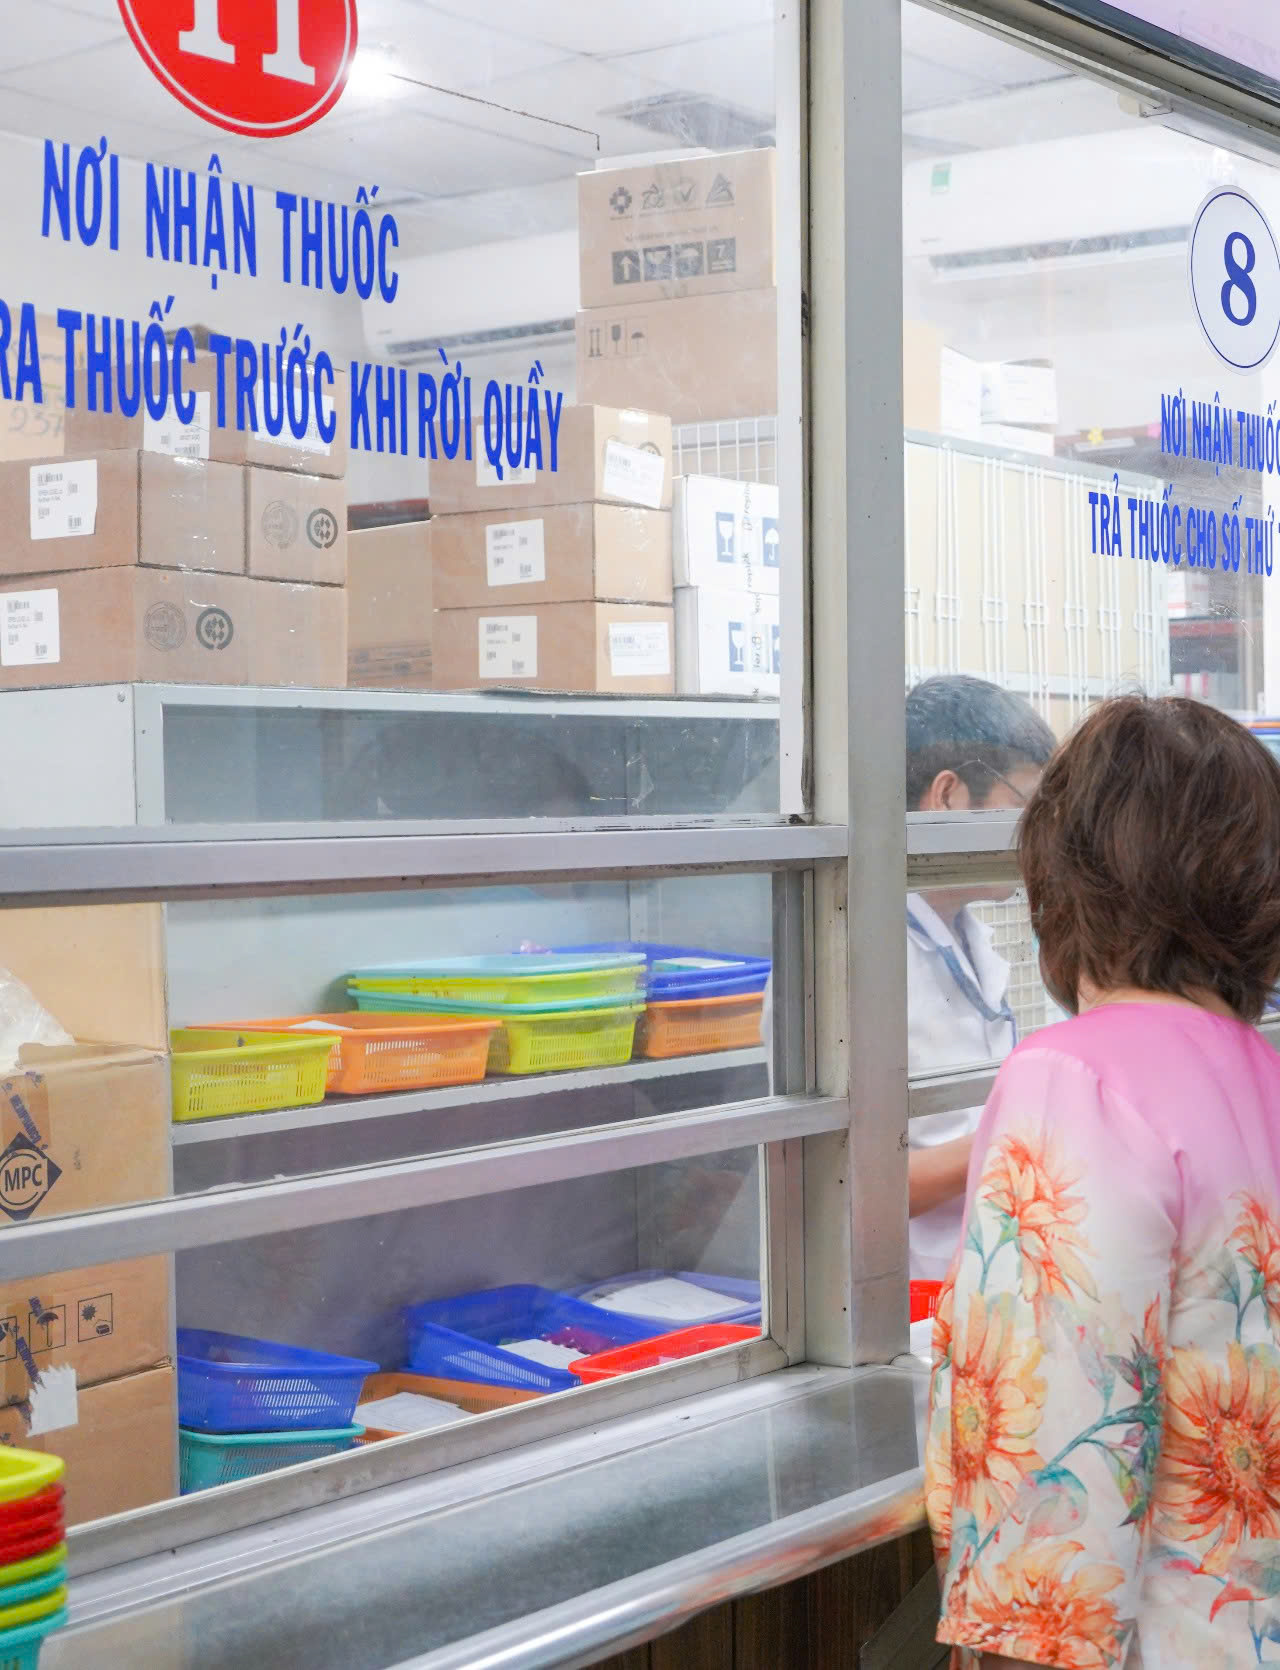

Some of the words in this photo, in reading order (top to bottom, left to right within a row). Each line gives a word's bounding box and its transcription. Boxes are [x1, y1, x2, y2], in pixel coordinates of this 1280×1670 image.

[41, 136, 119, 250] NƠI
[146, 154, 257, 290] NHẬN
[276, 186, 399, 303] THUỐC
[1221, 231, 1257, 326] 8
[57, 296, 196, 424] THUỐC
[208, 324, 336, 443] TRƯỚC
[350, 361, 408, 456] KHI
[418, 348, 473, 462] RỜI
[483, 359, 564, 480] QUẦY
[1161, 388, 1188, 457] NƠI
[1191, 391, 1233, 476] NHẬN
[1088, 472, 1122, 559] TRẢ
[1127, 483, 1184, 565] THUỐC
[1186, 506, 1217, 570] CHO
[1220, 494, 1242, 573] SỐ
[1244, 505, 1275, 577] THỨ
[5, 1163, 42, 1192] MPC
